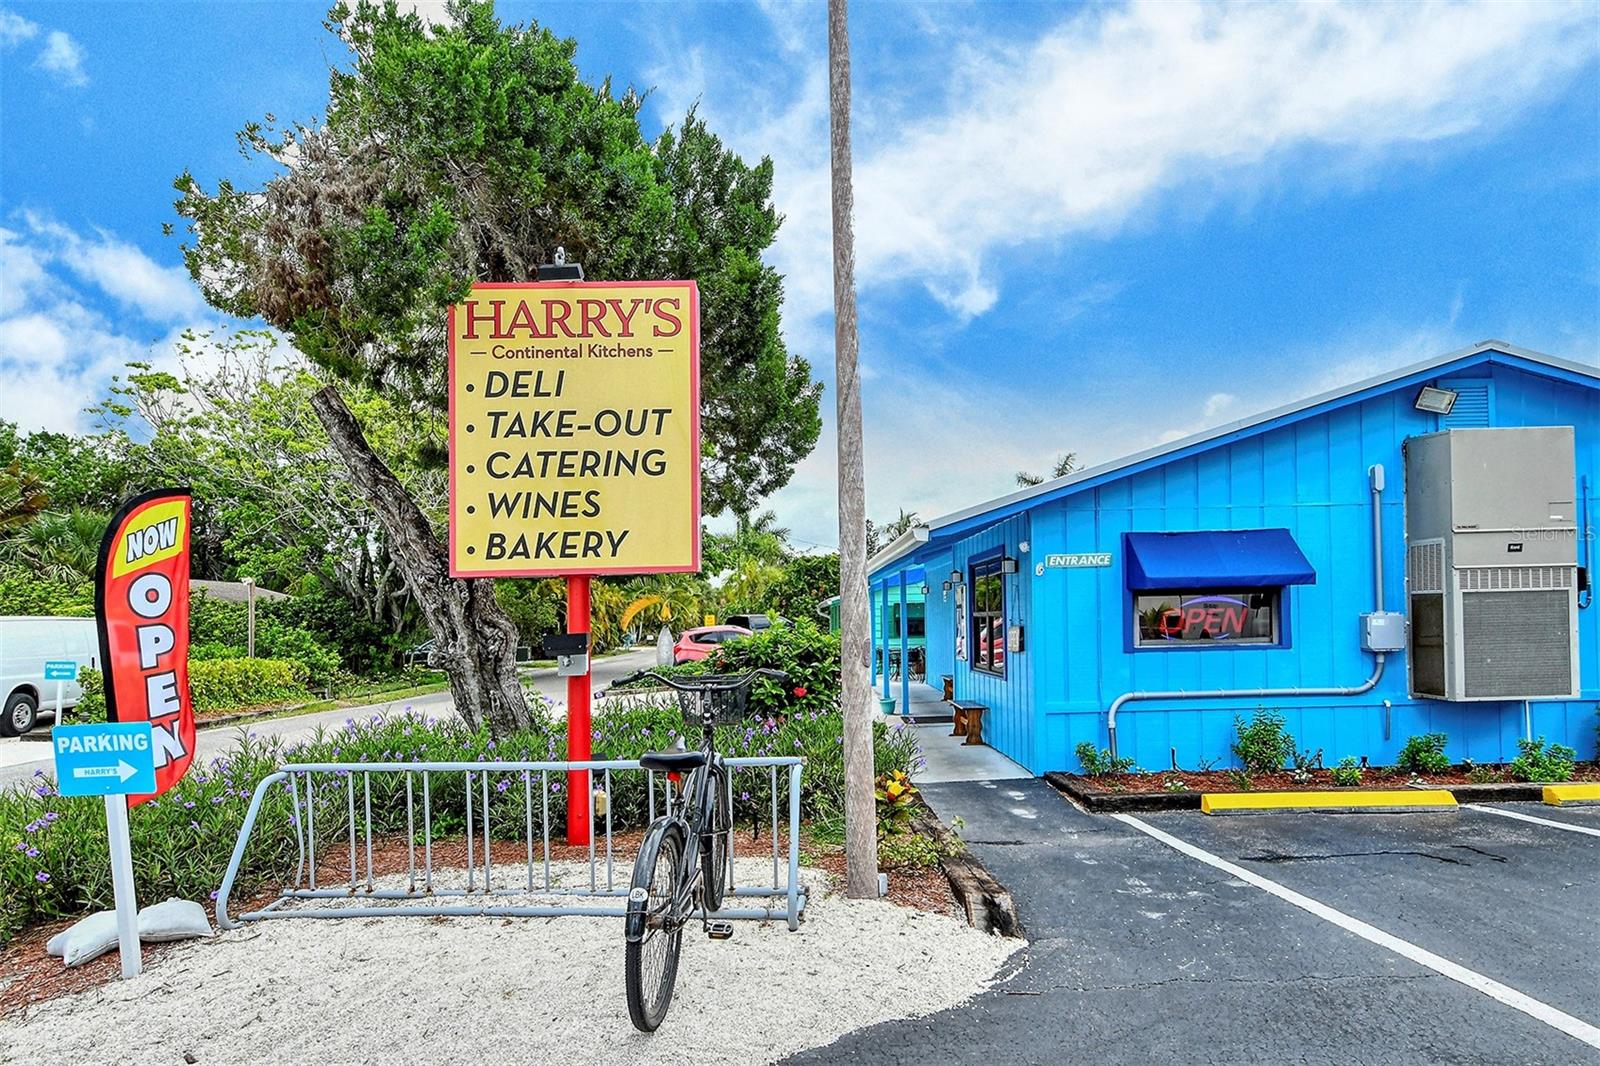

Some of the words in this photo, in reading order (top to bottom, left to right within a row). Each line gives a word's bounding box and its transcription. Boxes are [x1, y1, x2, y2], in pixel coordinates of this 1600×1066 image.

[462, 298, 682, 339] HARRY'S
[492, 344, 583, 359] Continental
[587, 343, 653, 358] Kitchens
[484, 370, 565, 398] DELI
[487, 408, 672, 438] TAKE-OUT
[486, 449, 667, 479] CATERING
[488, 490, 601, 519] WINES
[126, 516, 178, 563] NOW
[485, 530, 629, 560] BAKERY
[1049, 555, 1111, 566] ENTRANCE
[1158, 607, 1248, 634] OPEN
[127, 572, 188, 770] OPEN
[57, 733, 148, 754] PARKING
[84, 767, 118, 776] HARRY'S
